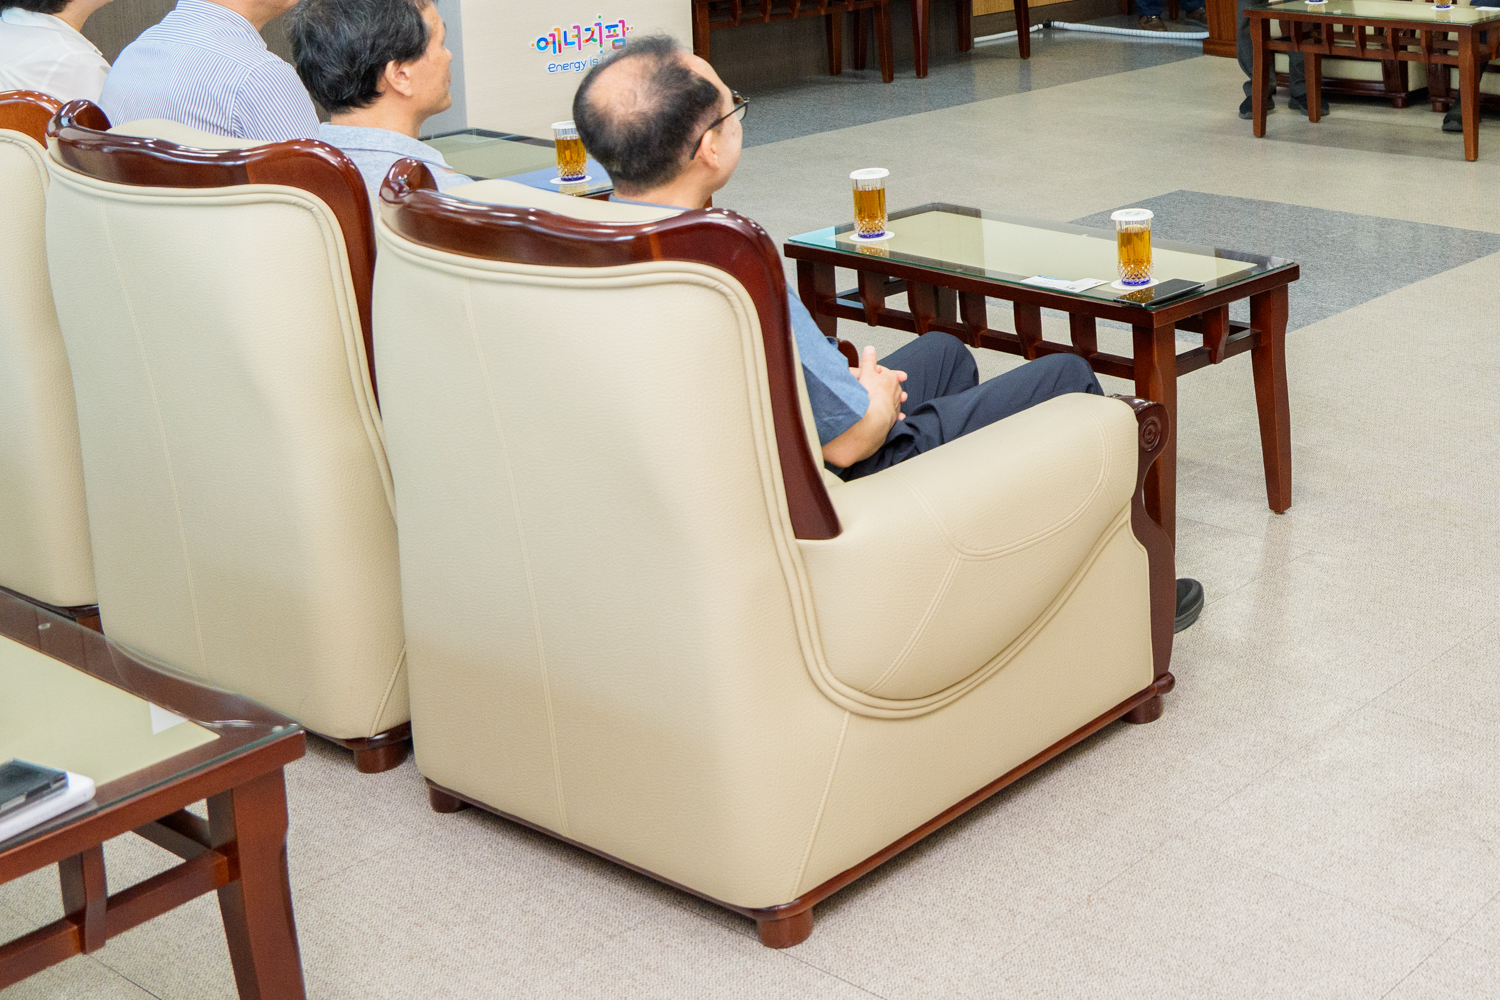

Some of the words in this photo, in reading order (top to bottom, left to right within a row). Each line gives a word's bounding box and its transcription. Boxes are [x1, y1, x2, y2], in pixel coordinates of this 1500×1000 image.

[531, 14, 634, 54] 에너지팜
[547, 59, 588, 73] energy
[589, 55, 600, 67] is
